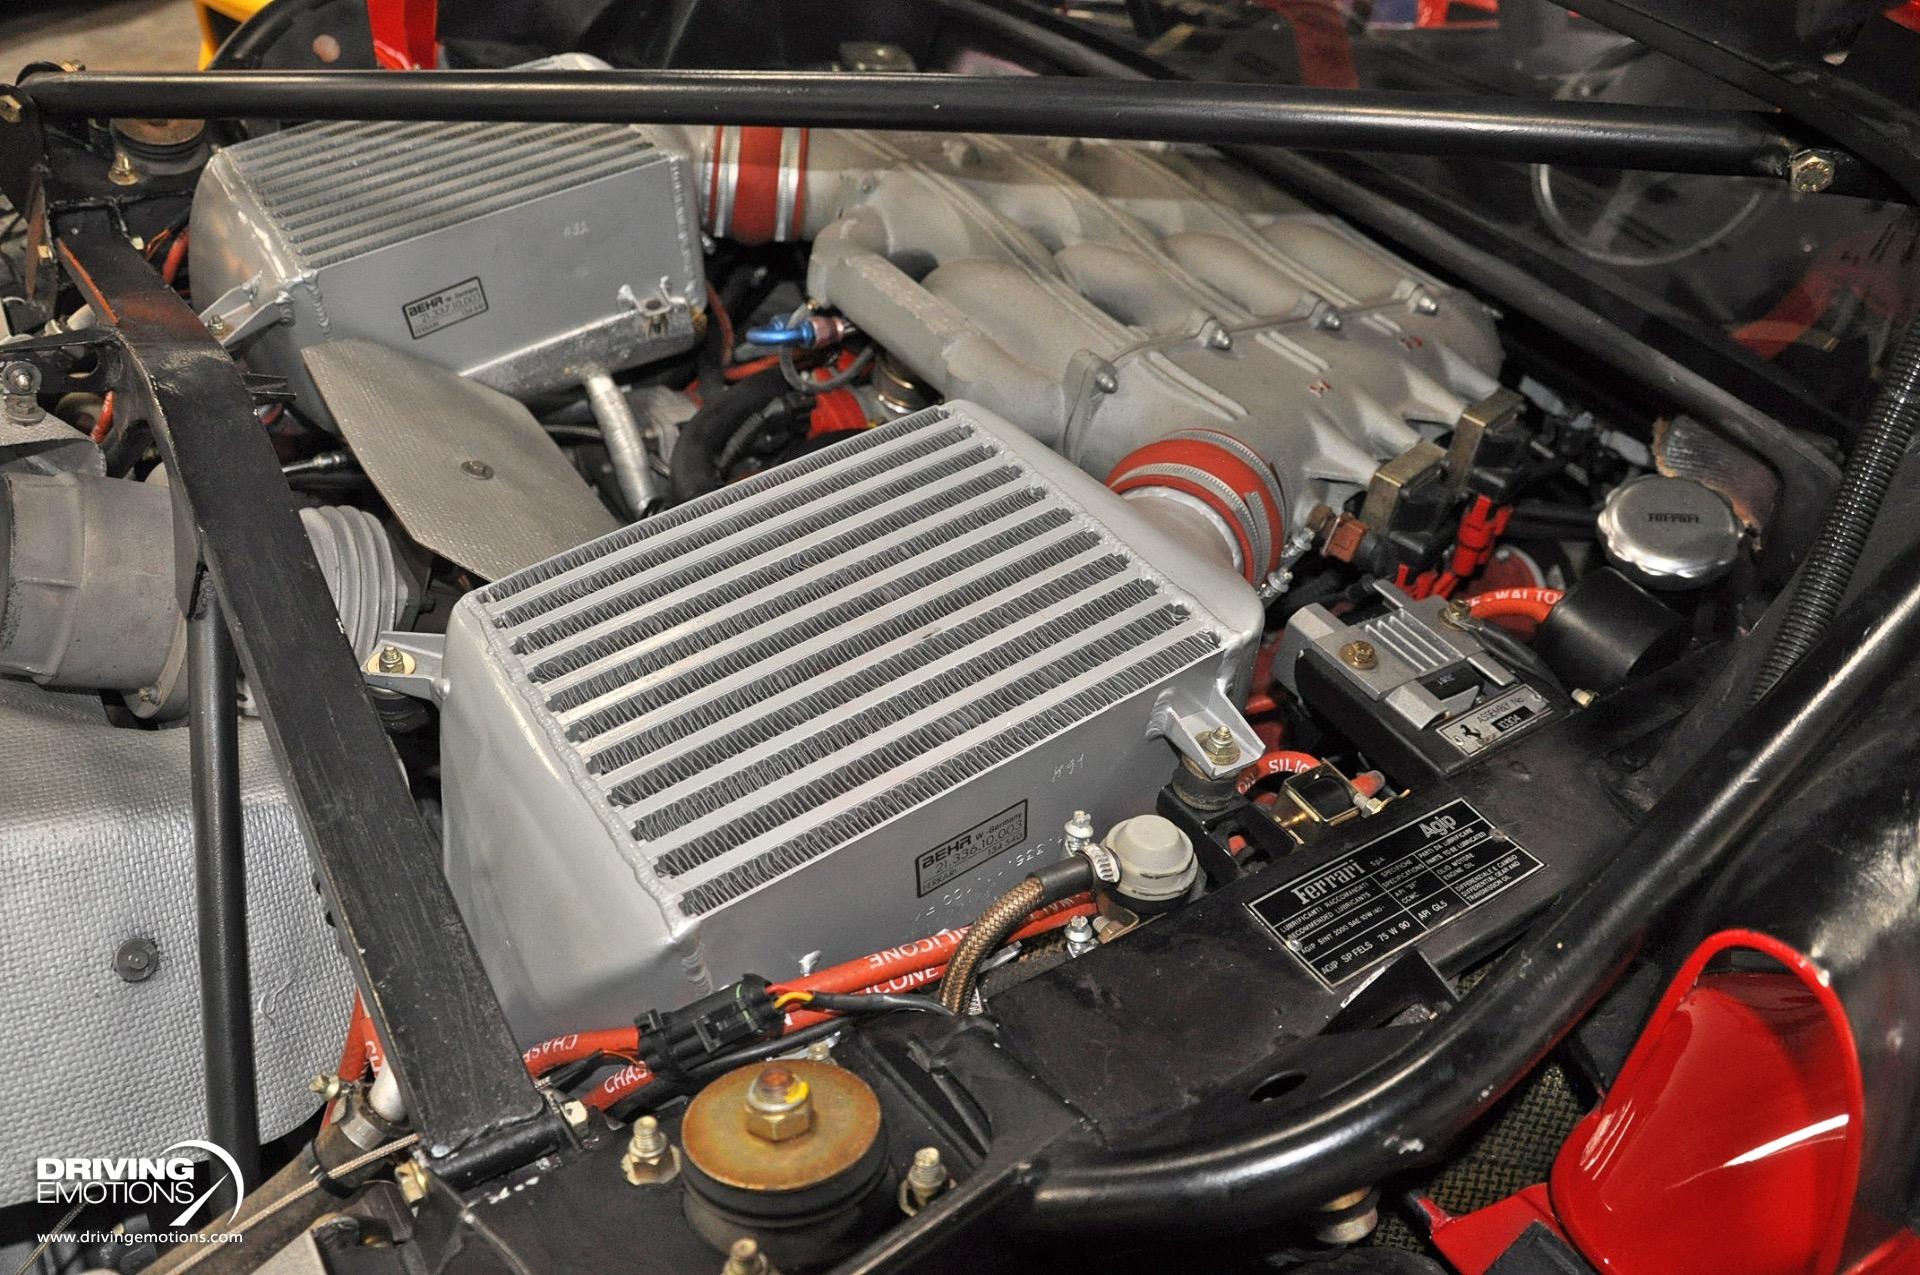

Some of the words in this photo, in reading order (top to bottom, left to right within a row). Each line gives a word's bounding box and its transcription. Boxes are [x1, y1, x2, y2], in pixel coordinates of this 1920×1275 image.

[408, 296, 444, 316] BEHR
[1419, 815, 1456, 838] Agip
[922, 834, 972, 869] BEHR
[1426, 853, 1443, 864] PARTS
[1291, 859, 1364, 904] Ferrari
[1334, 891, 1371, 913] LUBRICANTS
[1417, 909, 1431, 920] API
[1431, 900, 1448, 912] GL5
[1298, 942, 1315, 954] AGIP
[1317, 933, 1333, 945] SINT
[1321, 960, 1338, 974] AGIP
[1351, 941, 1373, 956] FELS
[1377, 932, 1389, 941] 75
[1387, 926, 1398, 935] W
[1398, 920, 1410, 930] 90
[604, 1060, 648, 1094] CHAS
